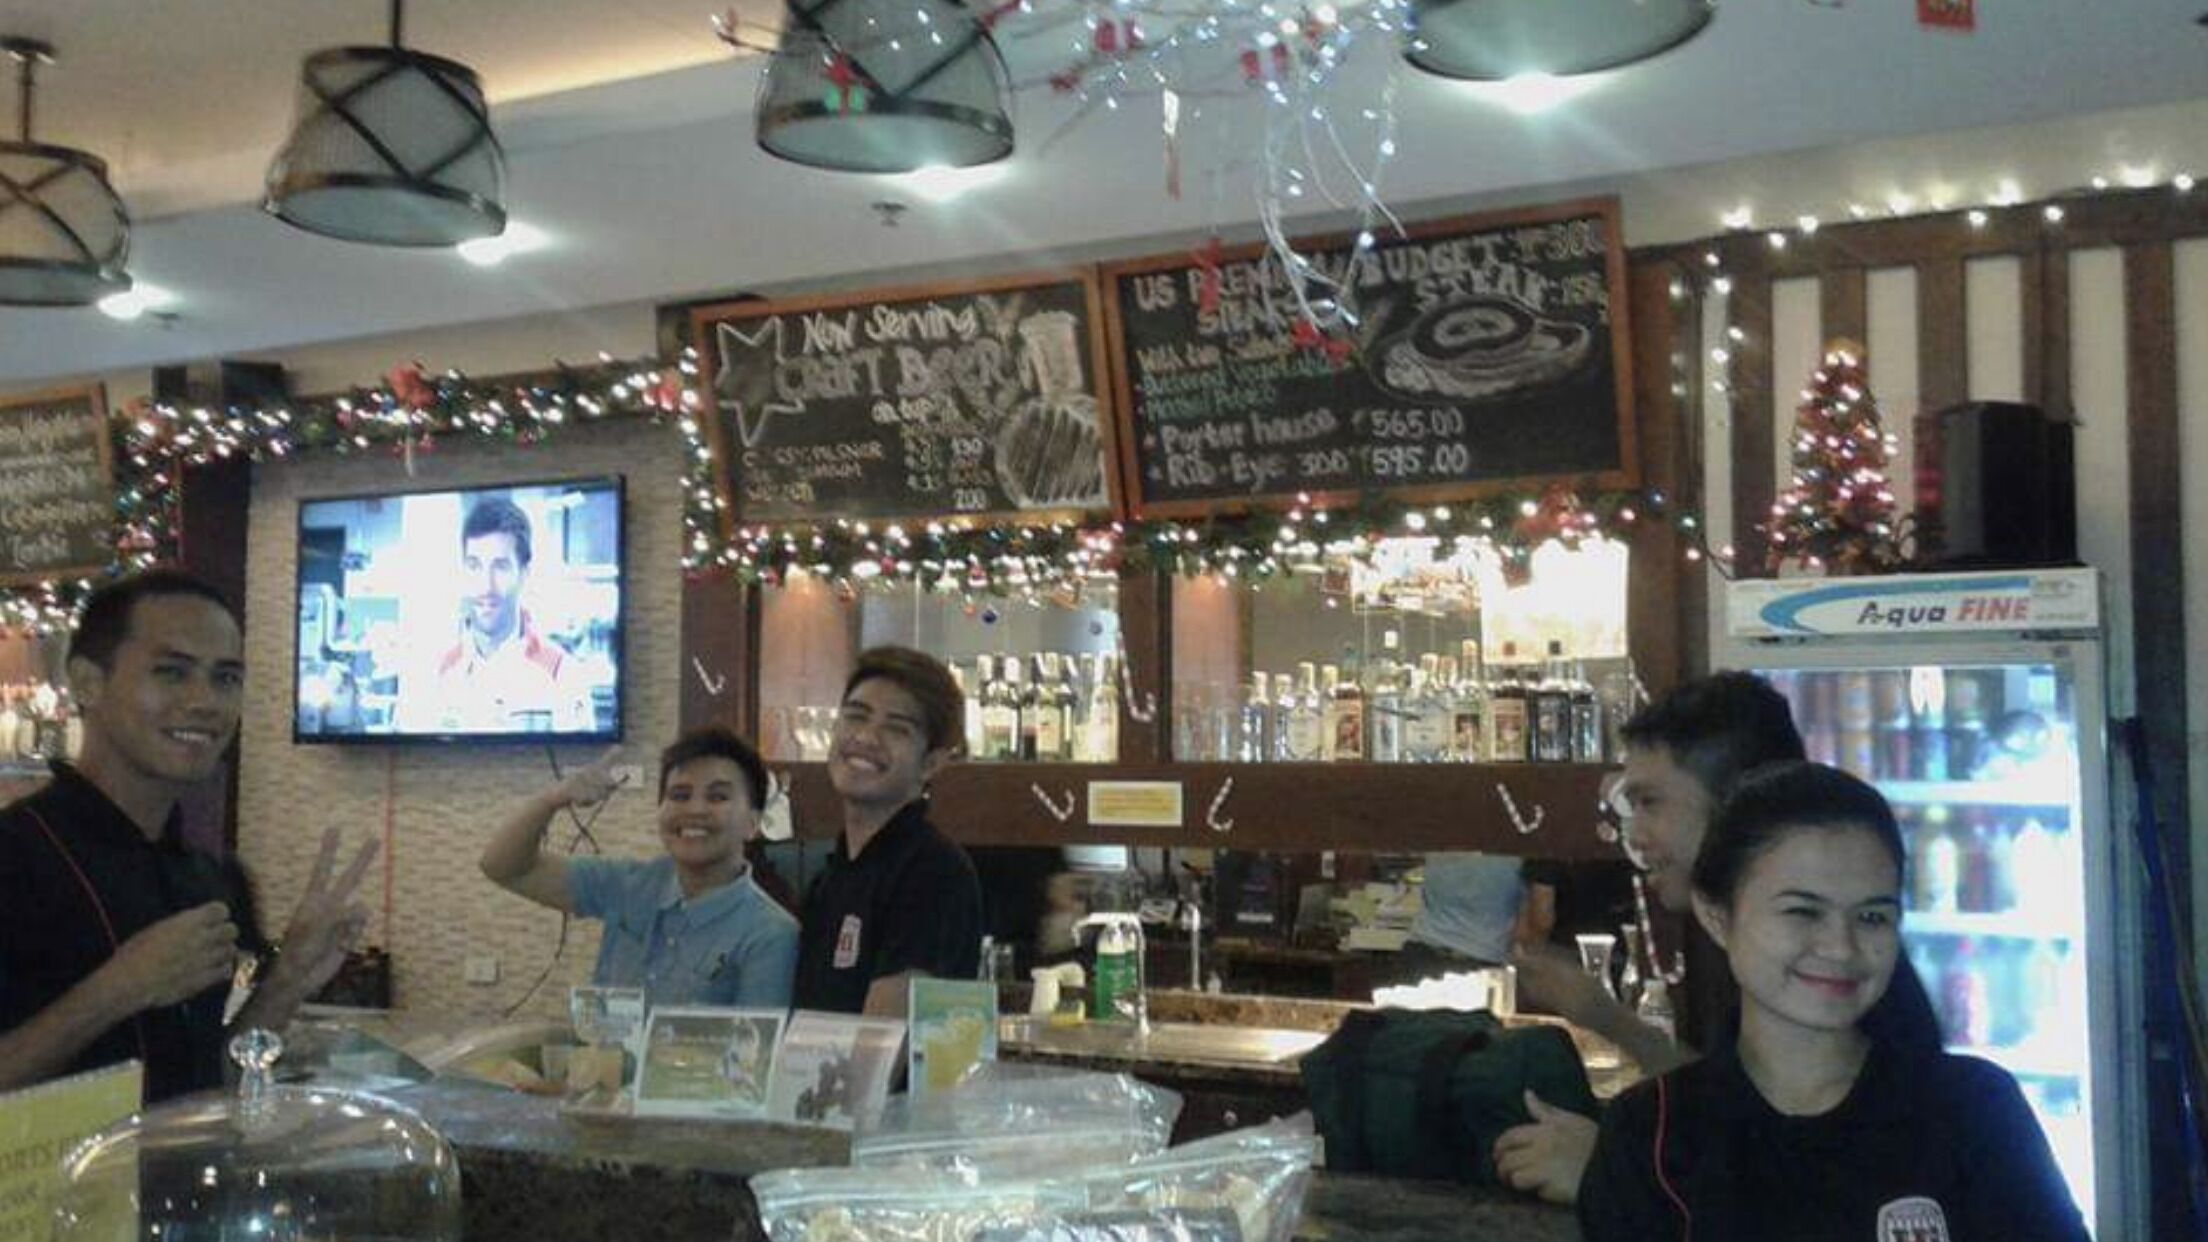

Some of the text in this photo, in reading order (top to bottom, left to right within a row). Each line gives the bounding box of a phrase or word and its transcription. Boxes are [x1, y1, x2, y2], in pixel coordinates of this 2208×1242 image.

[1134, 275, 1177, 311] US
[865, 300, 977, 341] Serving
[1371, 408, 1466, 441] 565.00
[1372, 444, 1471, 478] 595.00
[1857, 595, 2031, 628] Aqua FINE
